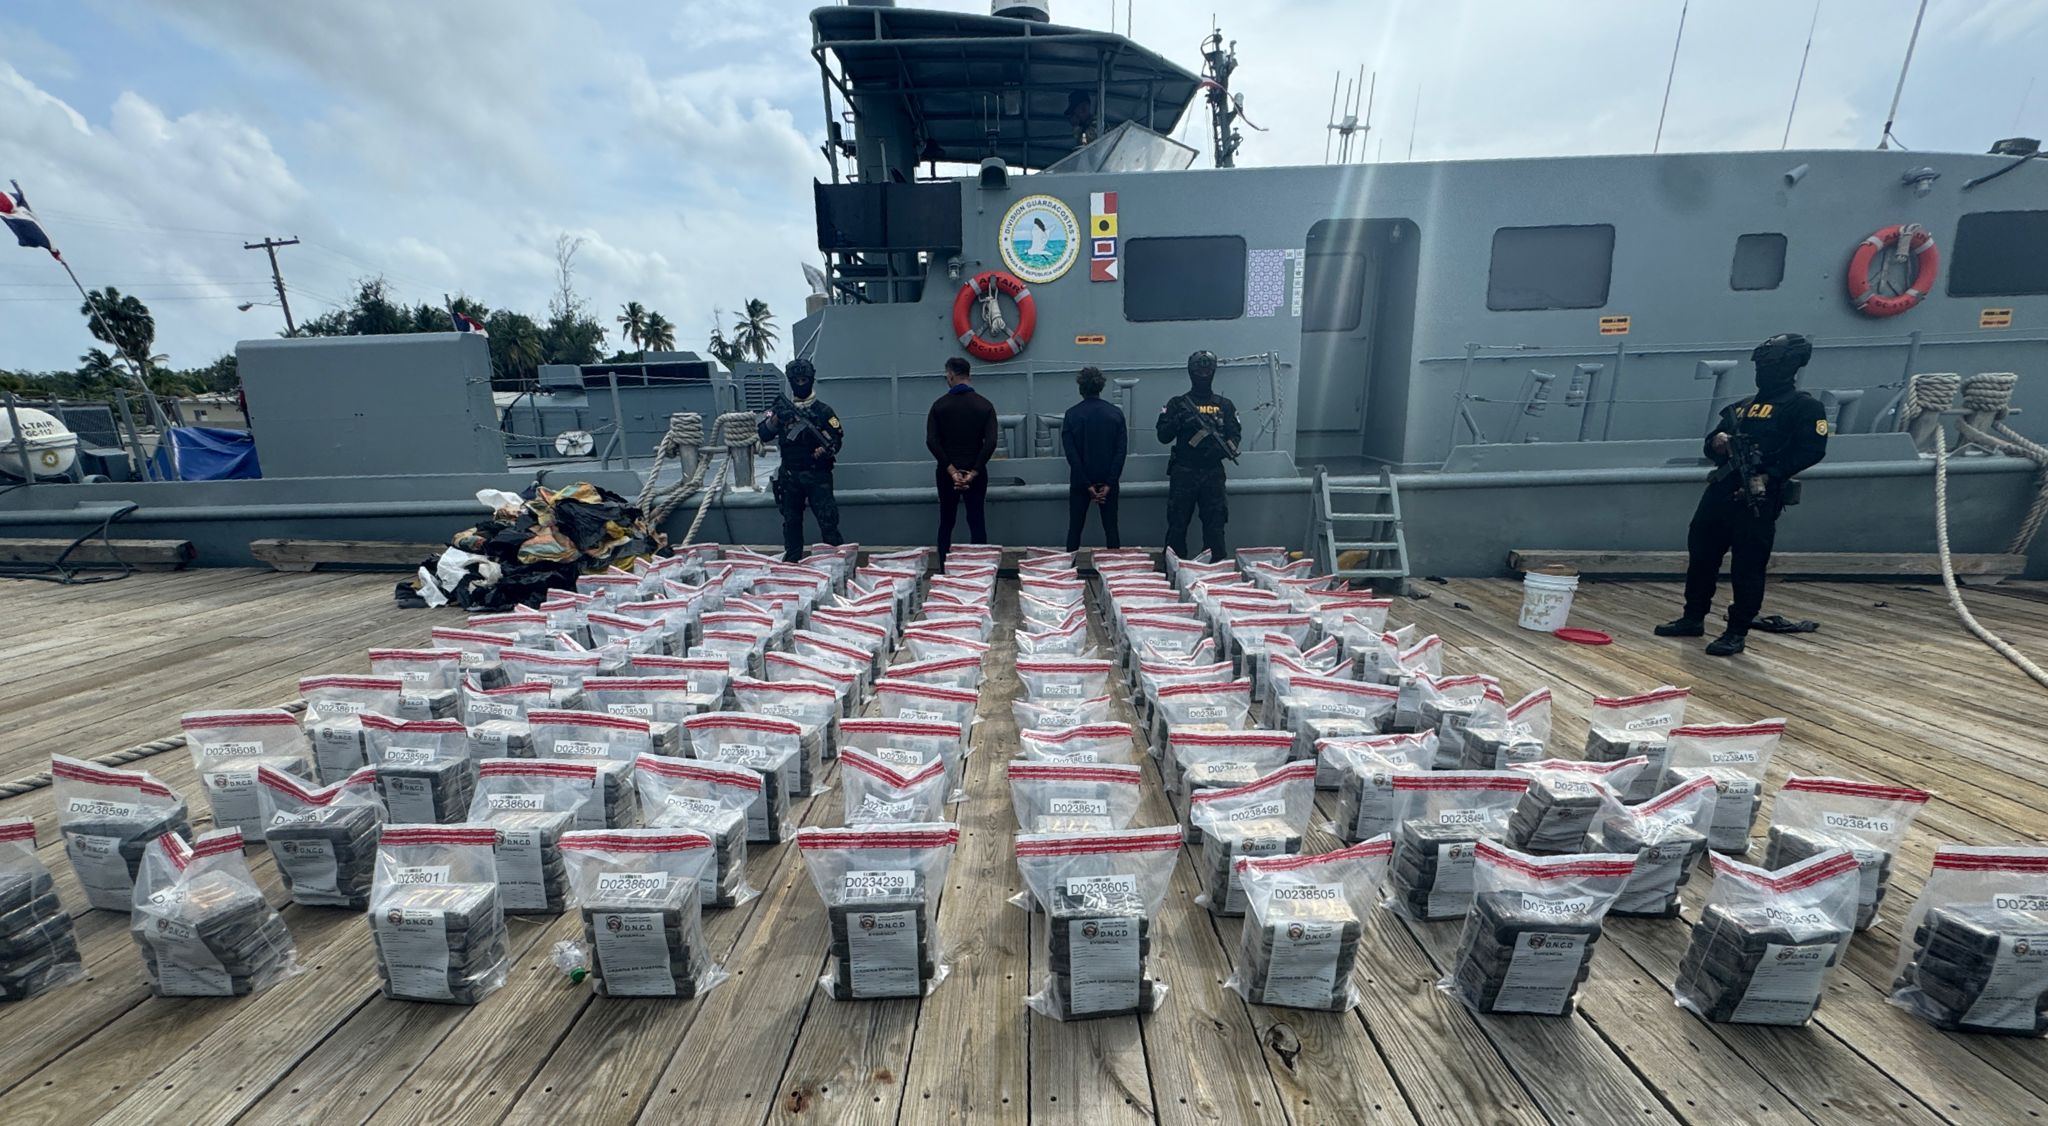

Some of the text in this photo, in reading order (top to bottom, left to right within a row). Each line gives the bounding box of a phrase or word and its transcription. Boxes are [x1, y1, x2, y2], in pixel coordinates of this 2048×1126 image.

[1005, 199, 1075, 235] DIVISION GUARDACOSTAS
[70, 803, 130, 818] D0238598
[1053, 803, 1103, 814] D0238621
[1231, 805, 1279, 822] D0238496
[1826, 815, 1890, 832] D0238416
[600, 878, 660, 890] D0238600
[845, 876, 905, 888] D0234239
[1071, 882, 1130, 895] D0238605
[1275, 888, 1336, 900] D0238505
[1522, 899, 1587, 915] D0238492
